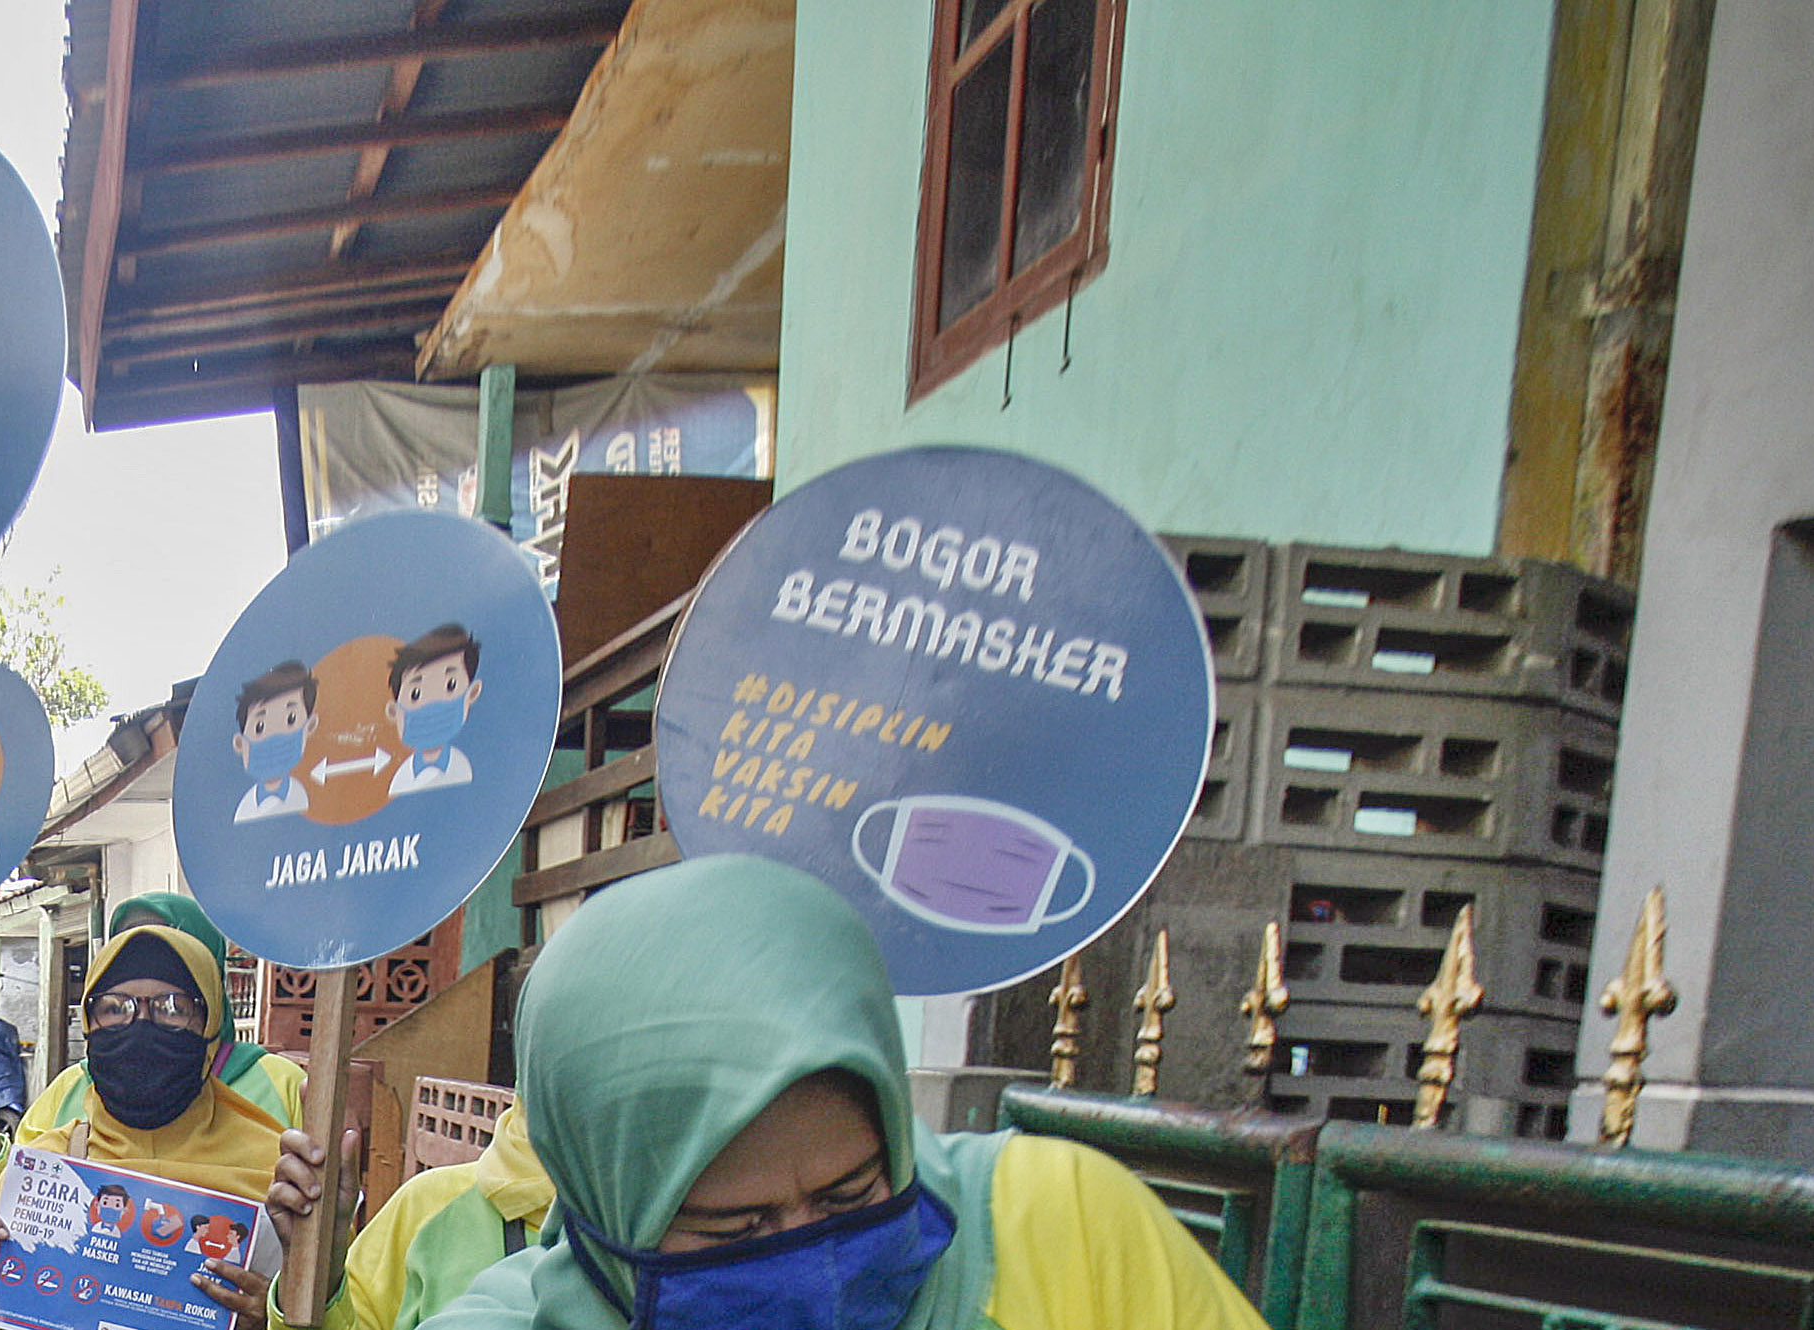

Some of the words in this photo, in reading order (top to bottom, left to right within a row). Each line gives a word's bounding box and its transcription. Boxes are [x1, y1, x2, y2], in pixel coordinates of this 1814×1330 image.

[839, 508, 1040, 603] BOGOR
[734, 672, 953, 754] #DISIPLIN
[719, 709, 816, 761] KITA
[711, 748, 860, 810] VAKSIN
[697, 784, 794, 836] KITA
[265, 848, 328, 889] JAGA
[336, 833, 421, 879] JARAK
[17, 1194, 65, 1214] MEMUTUS
[21, 1176, 34, 1192] 3
[37, 1179, 79, 1204] CARA
[10, 1220, 55, 1240] COVID-19
[13, 1207, 73, 1231] PENULARAN
[82, 1246, 120, 1264] MASKER
[90, 1236, 118, 1252] PAKAI
[104, 1284, 153, 1305] KAWASAN
[184, 1303, 218, 1320] ROKOK
